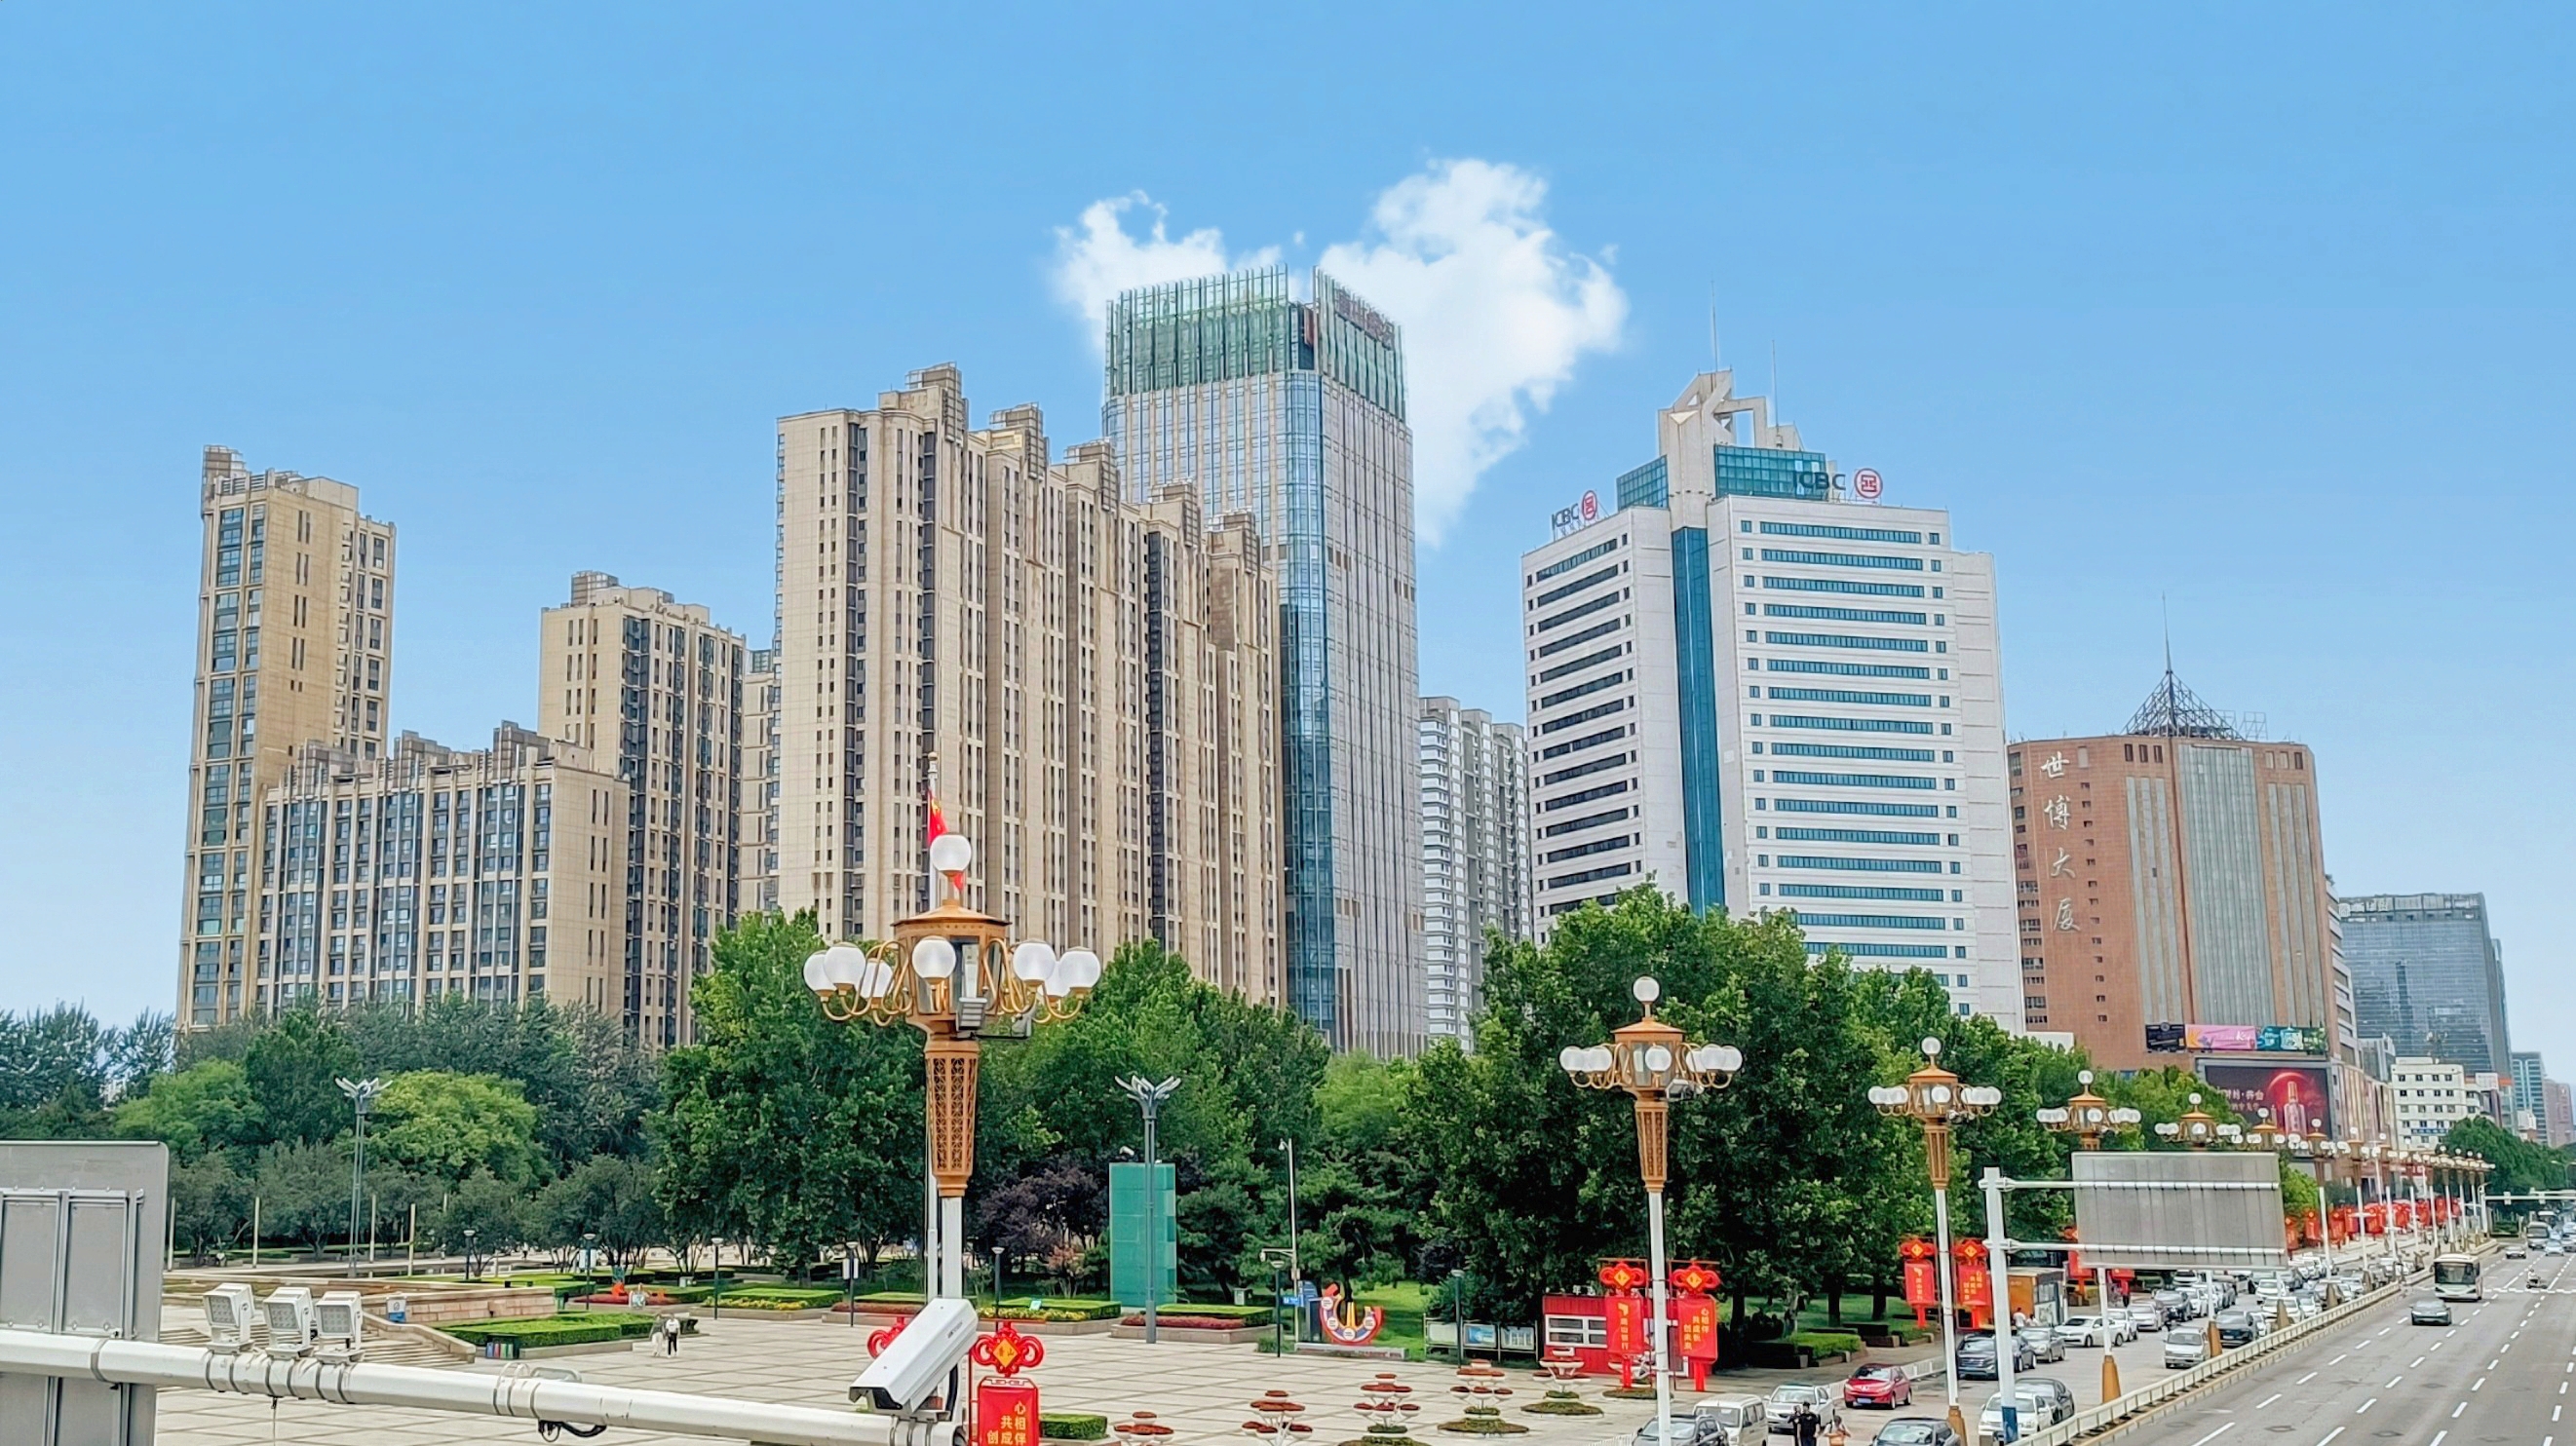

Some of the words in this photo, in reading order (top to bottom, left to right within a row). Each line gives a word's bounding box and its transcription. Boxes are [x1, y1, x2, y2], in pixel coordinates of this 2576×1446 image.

[1793, 471, 1846, 490] ICBC
[1551, 503, 1580, 531] ICBC
[2040, 750, 2081, 932] 世博大厦
[1015, 1401, 1026, 1445] 心相伴
